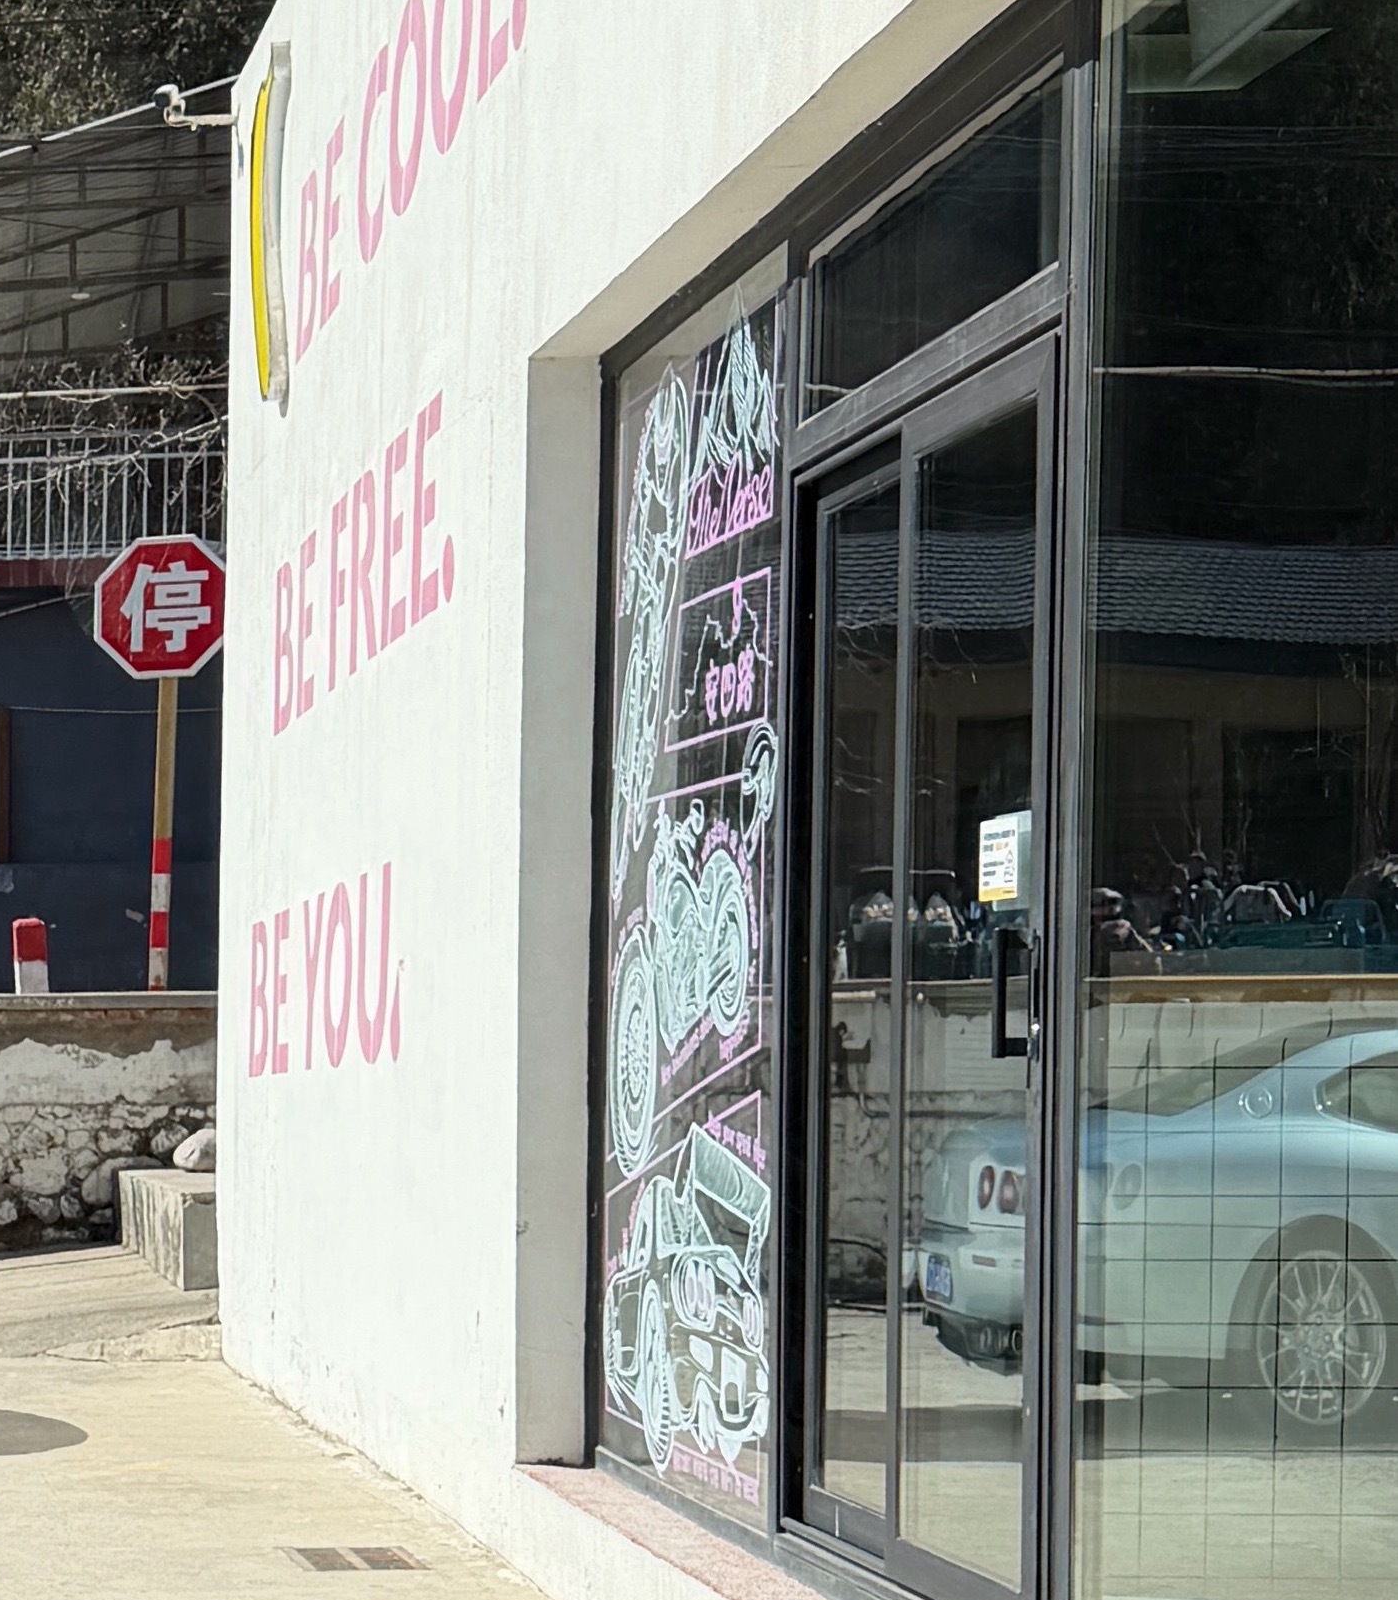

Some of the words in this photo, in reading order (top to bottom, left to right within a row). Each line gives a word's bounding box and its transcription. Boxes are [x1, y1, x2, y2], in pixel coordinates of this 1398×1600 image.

[296, 115, 345, 365] BE
[120, 560, 212, 653] 停
[274, 530, 315, 736] BE
[329, 389, 454, 693] FREE.
[249, 908, 290, 1078] BE
